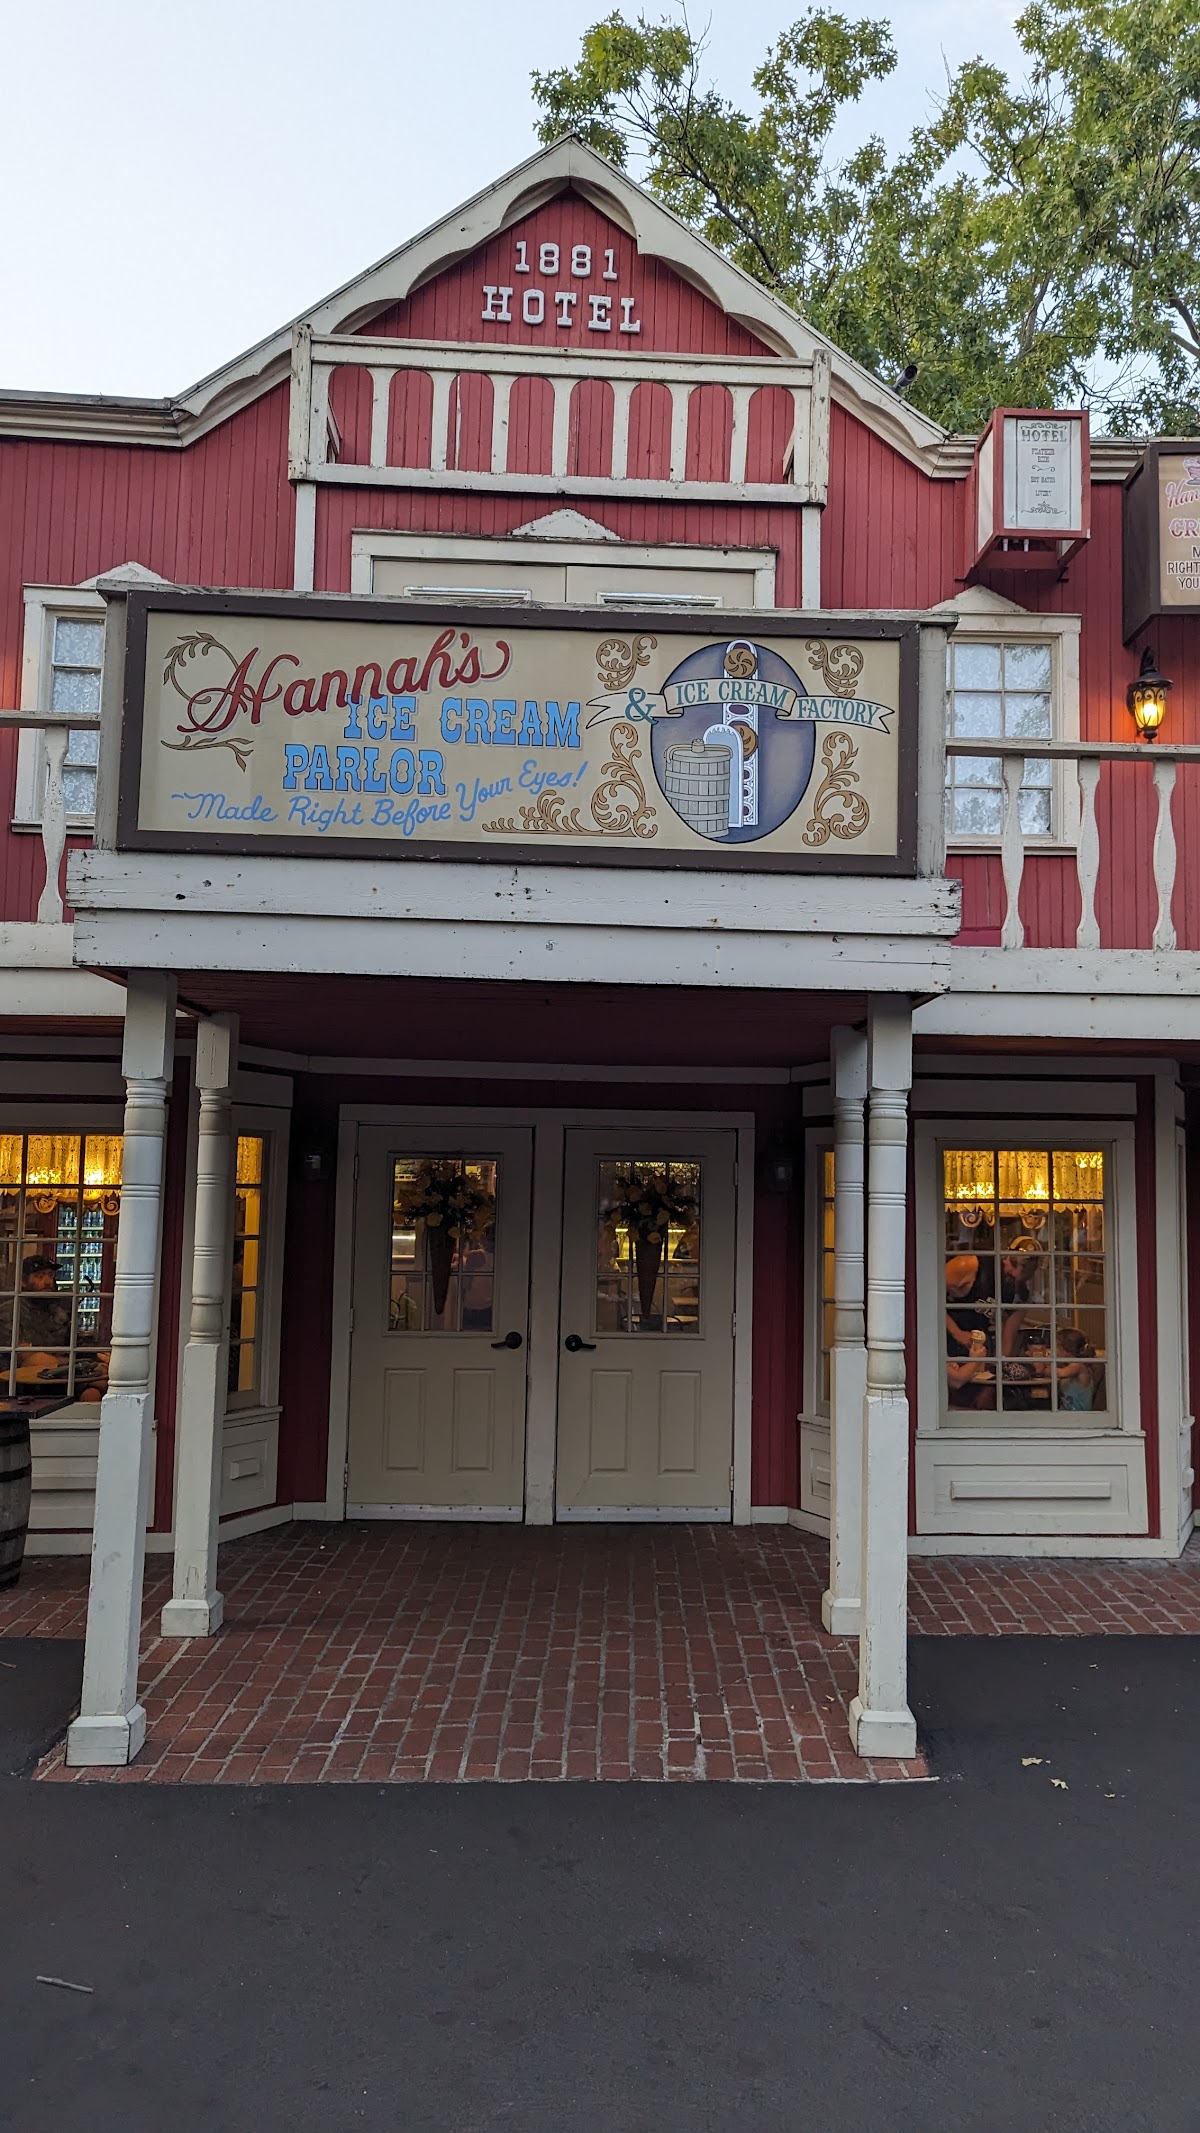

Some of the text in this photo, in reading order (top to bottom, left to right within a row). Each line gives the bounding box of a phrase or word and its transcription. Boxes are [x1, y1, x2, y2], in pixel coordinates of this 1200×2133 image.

[514, 240, 618, 282] 1881
[481, 285, 641, 334] HOTEL
[1021, 430, 1067, 442] HOTEL
[1168, 561, 1200, 574] RIGHT
[176, 628, 511, 733] Hannah's
[624, 680, 881, 726] & ICE CREAM FACTORY
[343, 693, 582, 748] ICE CREAM
[282, 743, 447, 795] PARLOR
[174, 759, 589, 837] Made Right Before Your Eyes!
